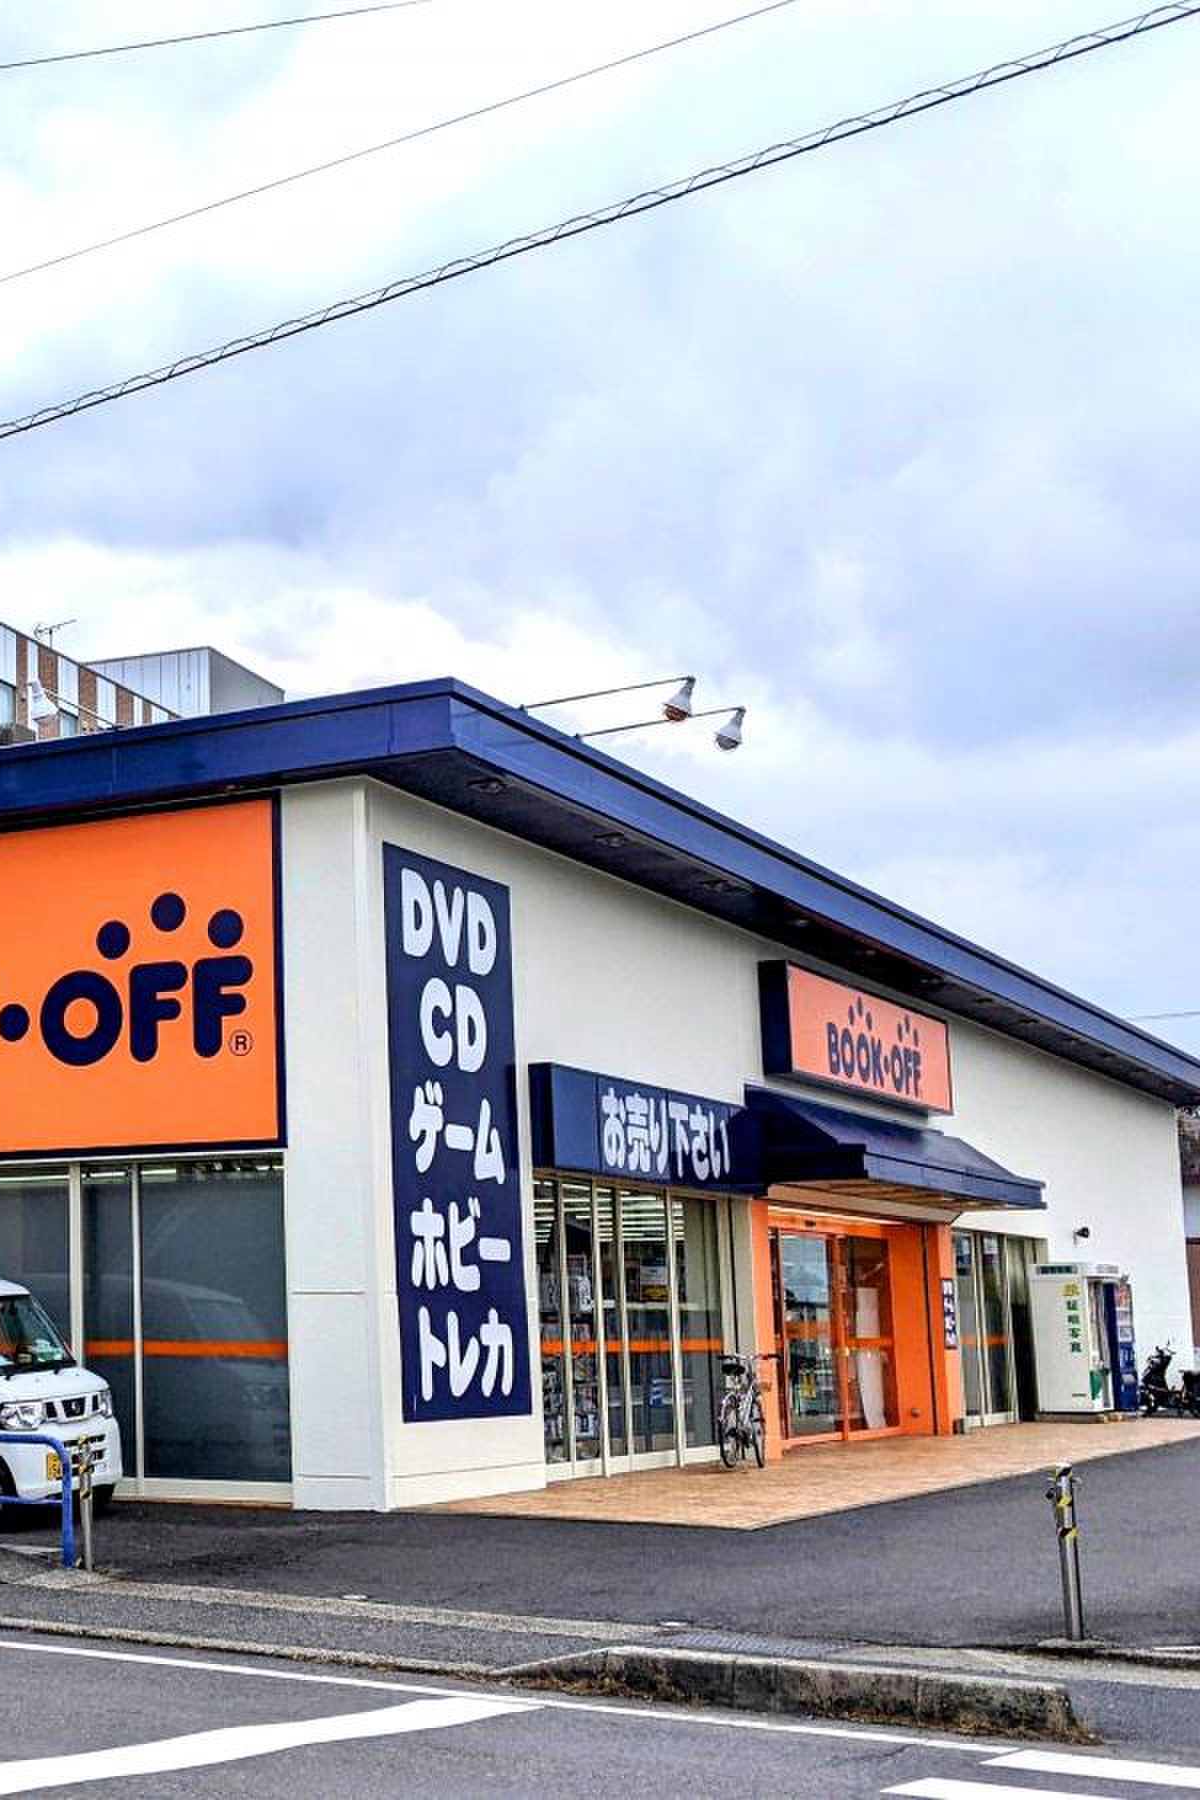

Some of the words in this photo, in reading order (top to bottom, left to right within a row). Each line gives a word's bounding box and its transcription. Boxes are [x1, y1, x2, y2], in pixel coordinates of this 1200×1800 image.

[401, 867, 497, 976] DVD
[420, 977, 487, 1073] CD
[410, 1080, 506, 1185] ゲーム
[602, 1087, 730, 1181] お売り下さい
[411, 1197, 511, 1292] ホビー
[418, 1306, 514, 1402] トレカ
